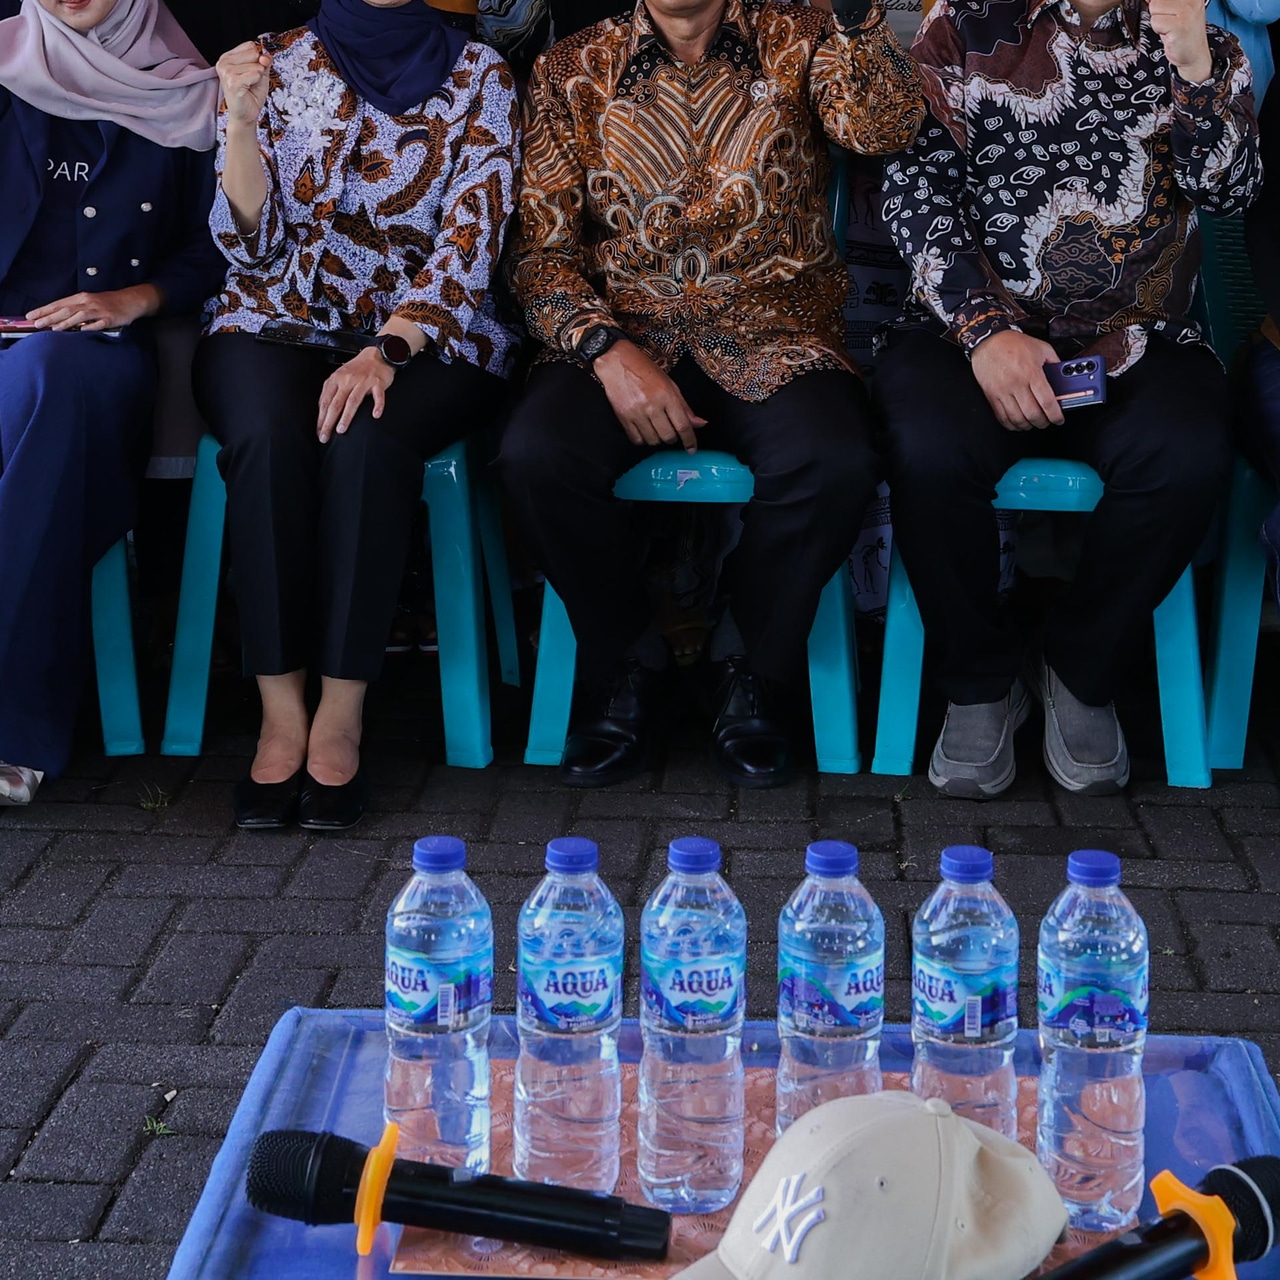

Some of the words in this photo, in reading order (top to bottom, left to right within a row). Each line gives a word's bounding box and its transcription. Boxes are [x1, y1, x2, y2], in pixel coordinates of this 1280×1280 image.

[386, 961, 431, 994] QUA
[544, 968, 609, 998] AQUA
[669, 966, 734, 997] AQUA
